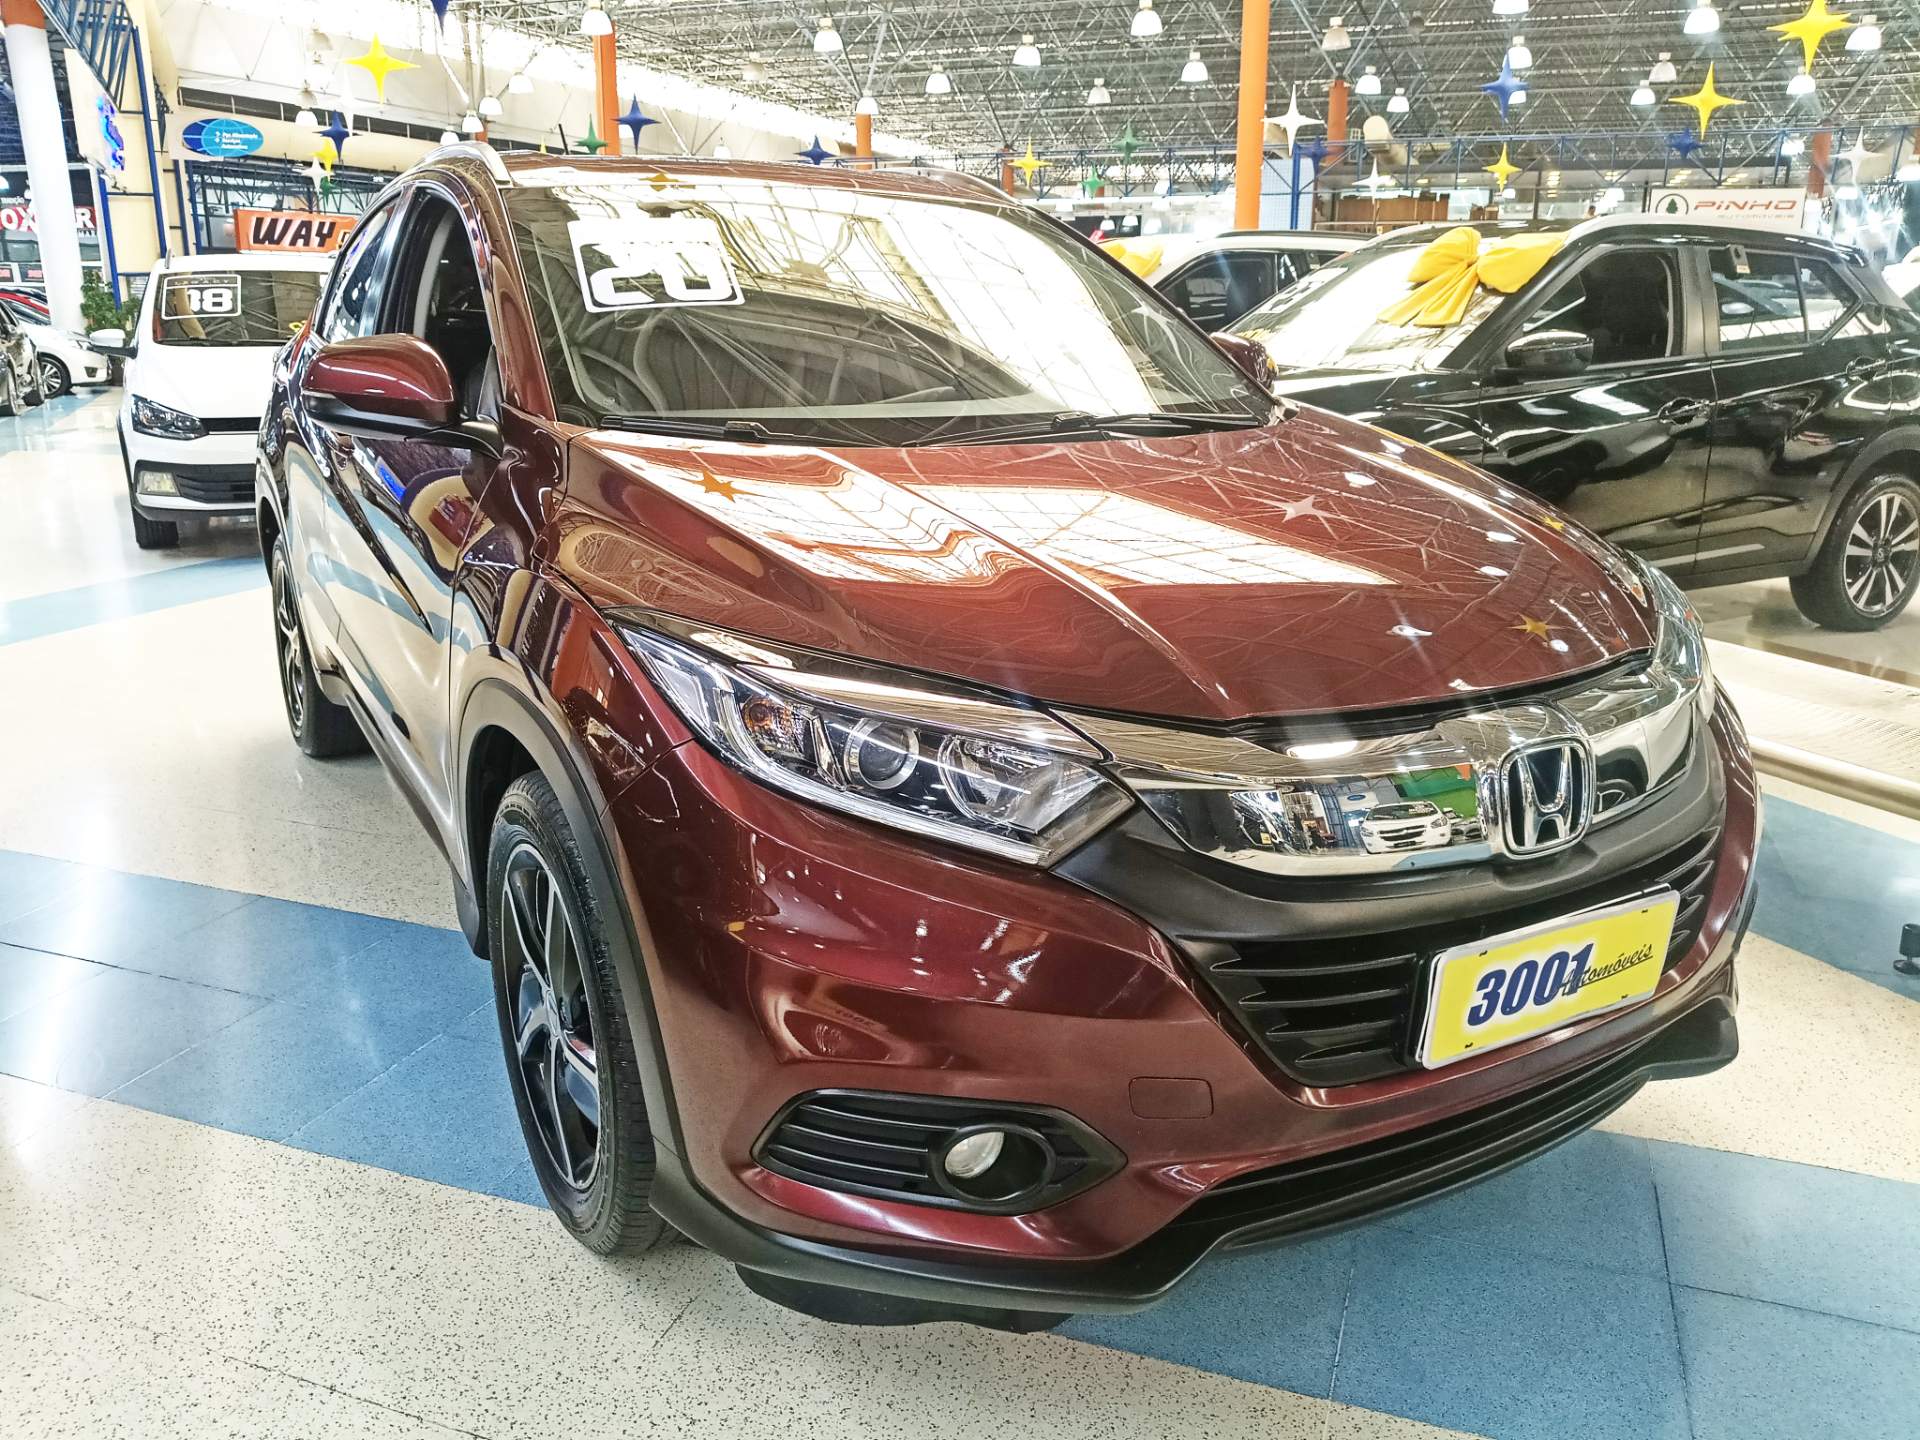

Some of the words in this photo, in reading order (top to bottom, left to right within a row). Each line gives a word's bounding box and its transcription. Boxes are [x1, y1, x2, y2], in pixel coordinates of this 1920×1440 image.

[252, 216, 337, 248] WAY
[588, 240, 734, 305] 20
[186, 287, 233, 313] 18
[1467, 943, 1594, 1026] 3001
